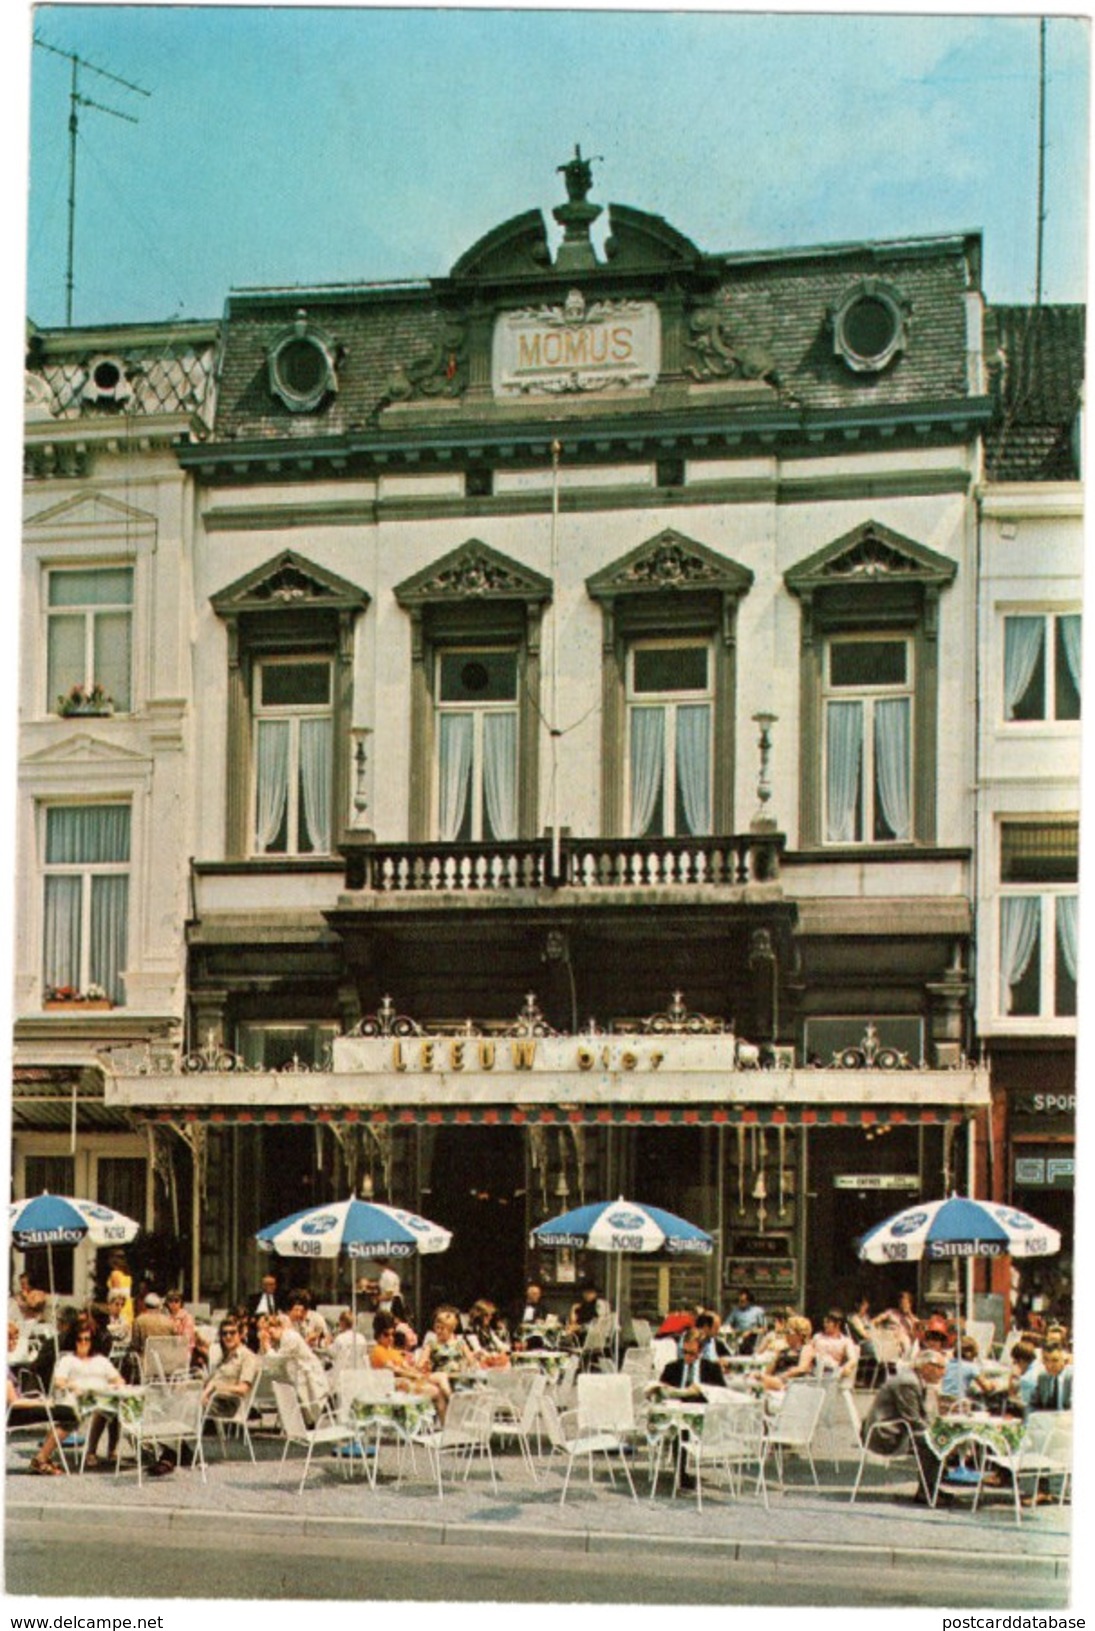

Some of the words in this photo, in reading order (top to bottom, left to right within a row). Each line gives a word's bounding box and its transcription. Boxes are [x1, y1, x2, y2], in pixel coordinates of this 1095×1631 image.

[518, 327, 633, 366] MOMUS
[391, 1040, 537, 1072] LEEUW
[19, 1226, 82, 1243] Sinalco
[537, 1232, 585, 1249] Sinalco
[612, 1234, 643, 1250] Kola
[292, 1240, 322, 1256] Kola
[347, 1239, 410, 1258] Sinalco
[931, 1238, 1001, 1258] Sinalco
